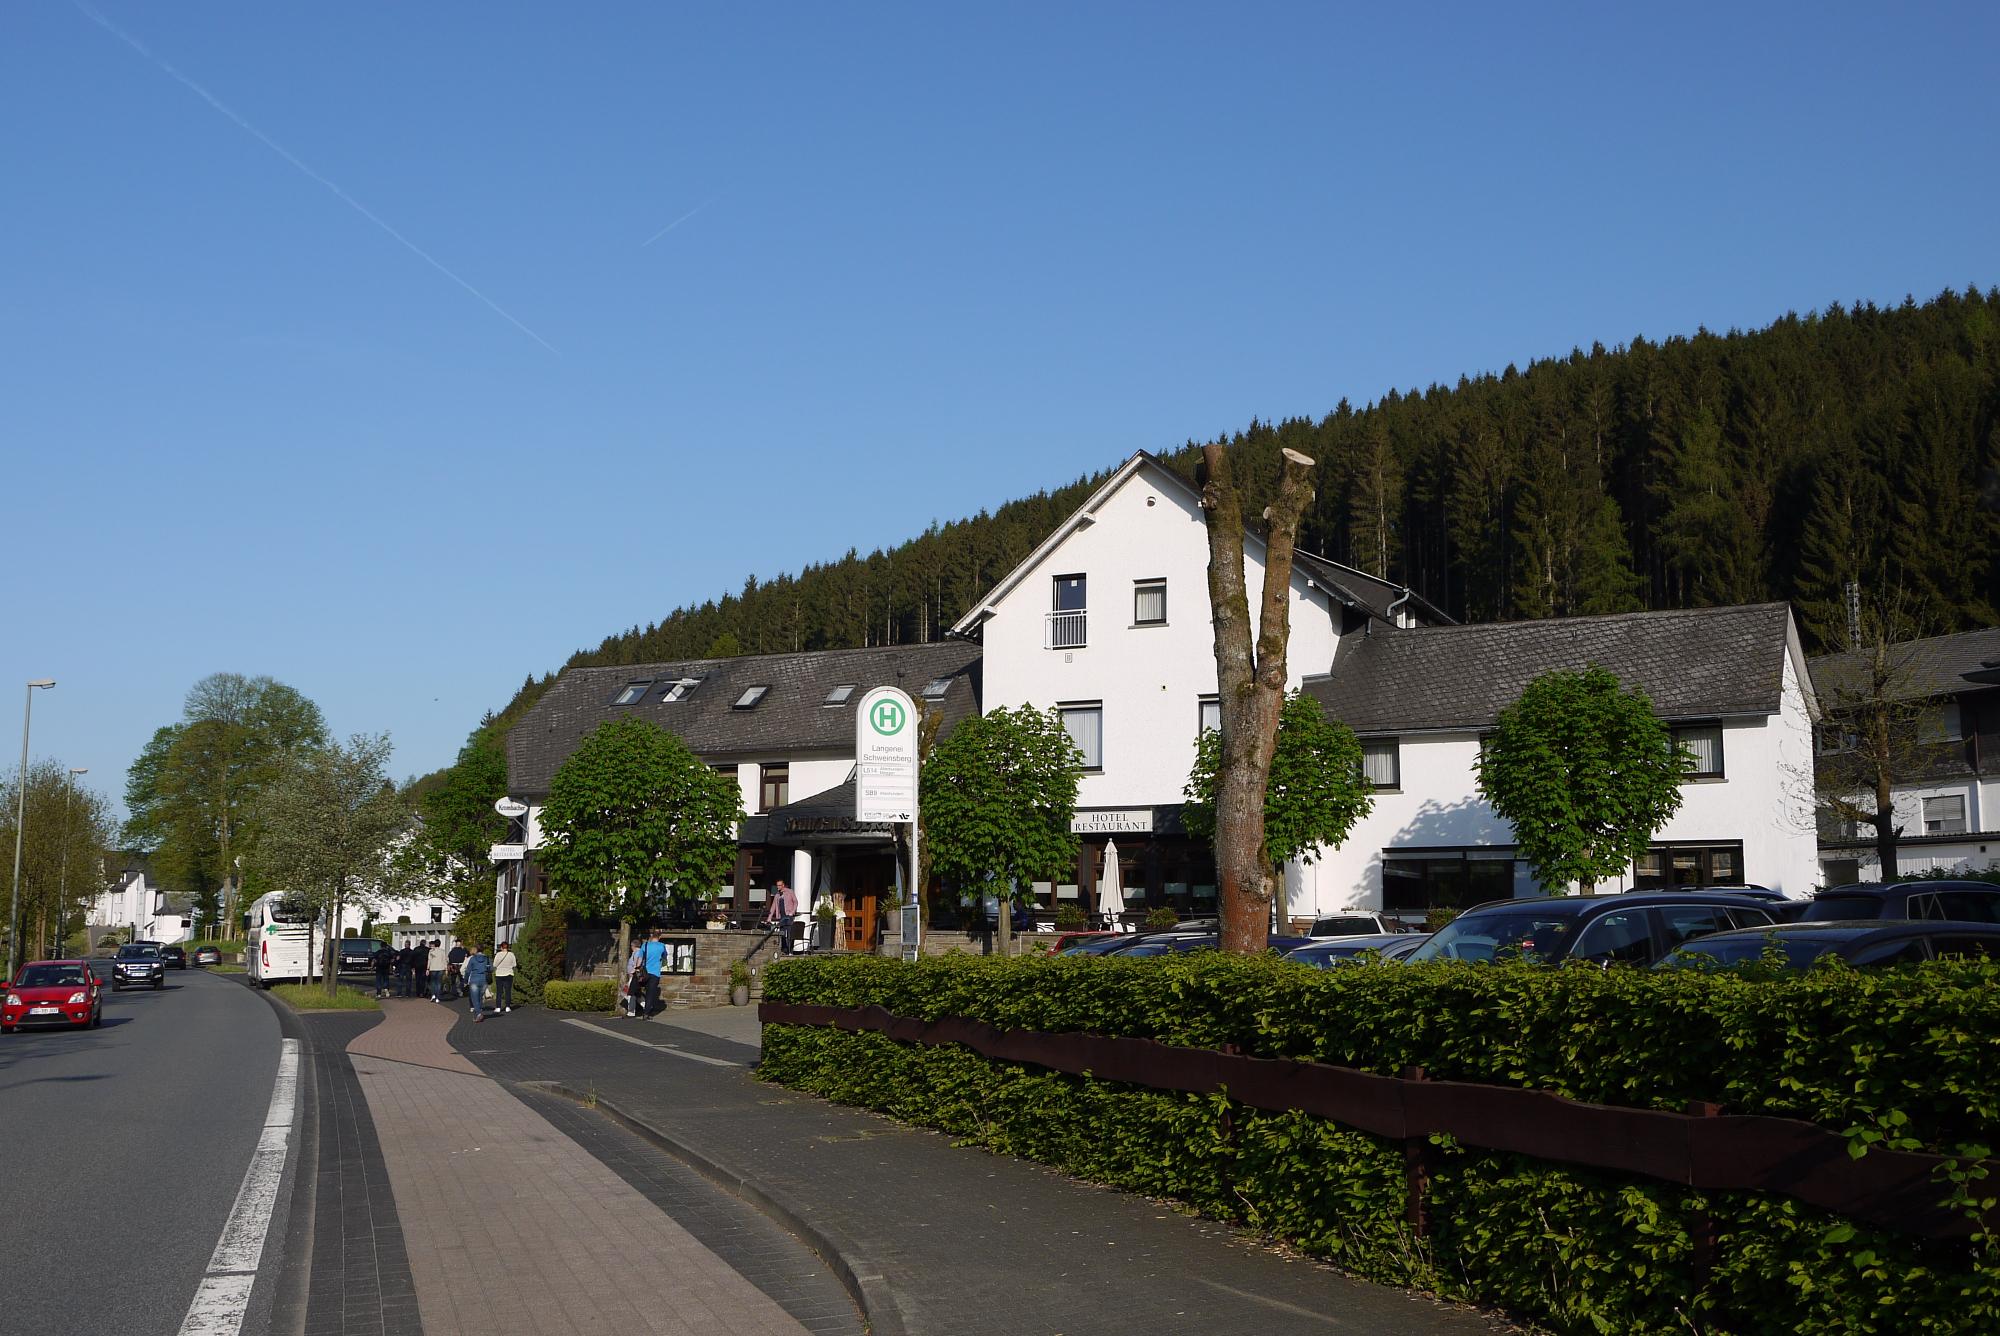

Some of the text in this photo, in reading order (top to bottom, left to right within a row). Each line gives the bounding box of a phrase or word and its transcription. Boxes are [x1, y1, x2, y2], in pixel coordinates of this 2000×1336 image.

[871, 745, 904, 754] Langenei
[863, 754, 912, 763] Schweinsberg
[1092, 813, 1128, 822] HOTEL
[1075, 822, 1147, 831] RESTAURANT
